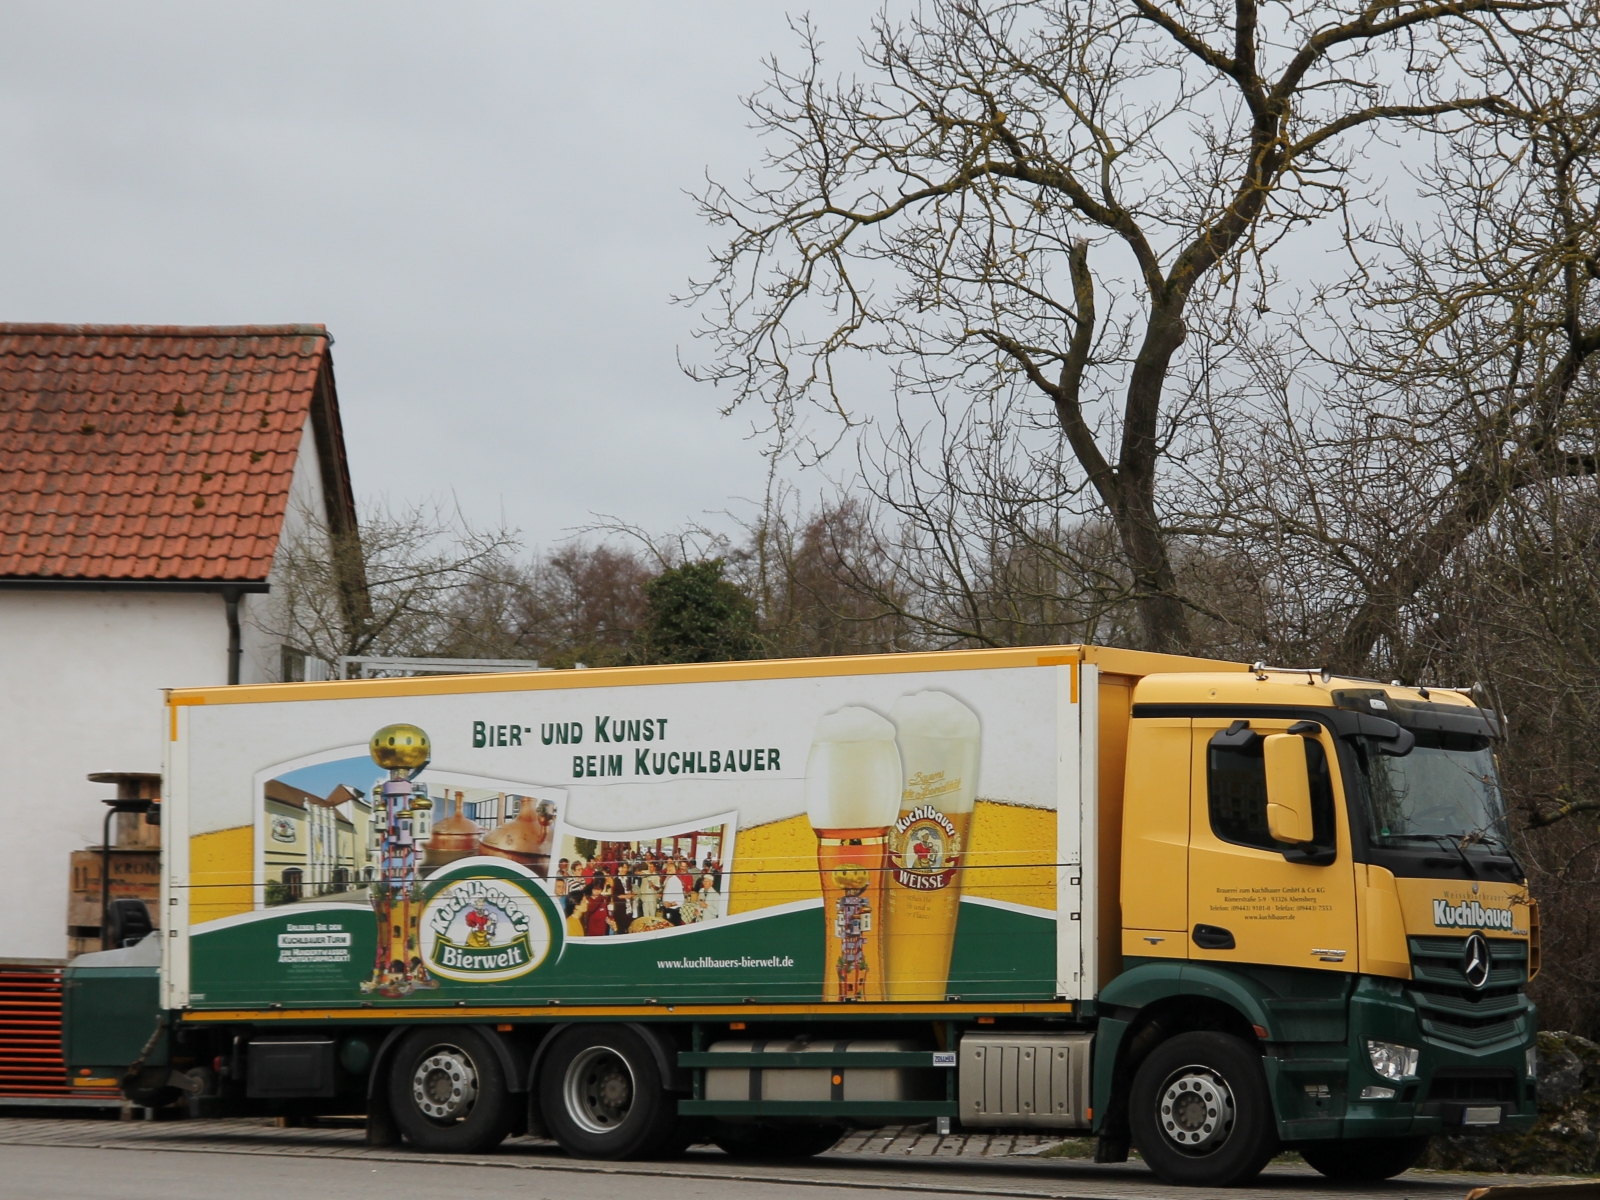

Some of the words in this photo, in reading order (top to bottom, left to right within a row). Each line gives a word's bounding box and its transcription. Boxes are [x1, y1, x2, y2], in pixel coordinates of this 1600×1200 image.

[472, 720, 532, 748] BIER-
[541, 721, 583, 745] UND
[595, 715, 668, 743] KUNST
[572, 754, 623, 778] BEIM
[634, 748, 781, 776] KUCHLBAUER
[895, 805, 956, 836] Kuchlbauer
[899, 869, 945, 889] WEISSE
[1216, 886, 1238, 894] Brauerei
[1251, 886, 1281, 894] Kuchlbauer
[1282, 886, 1300, 894] GmbH
[429, 880, 530, 936] Kuchlbauer's
[1433, 899, 1513, 930] Kuchlbauer
[442, 946, 522, 969] Bierwelt
[656, 955, 794, 969] www.kuchlbauers-bierwelt.de
